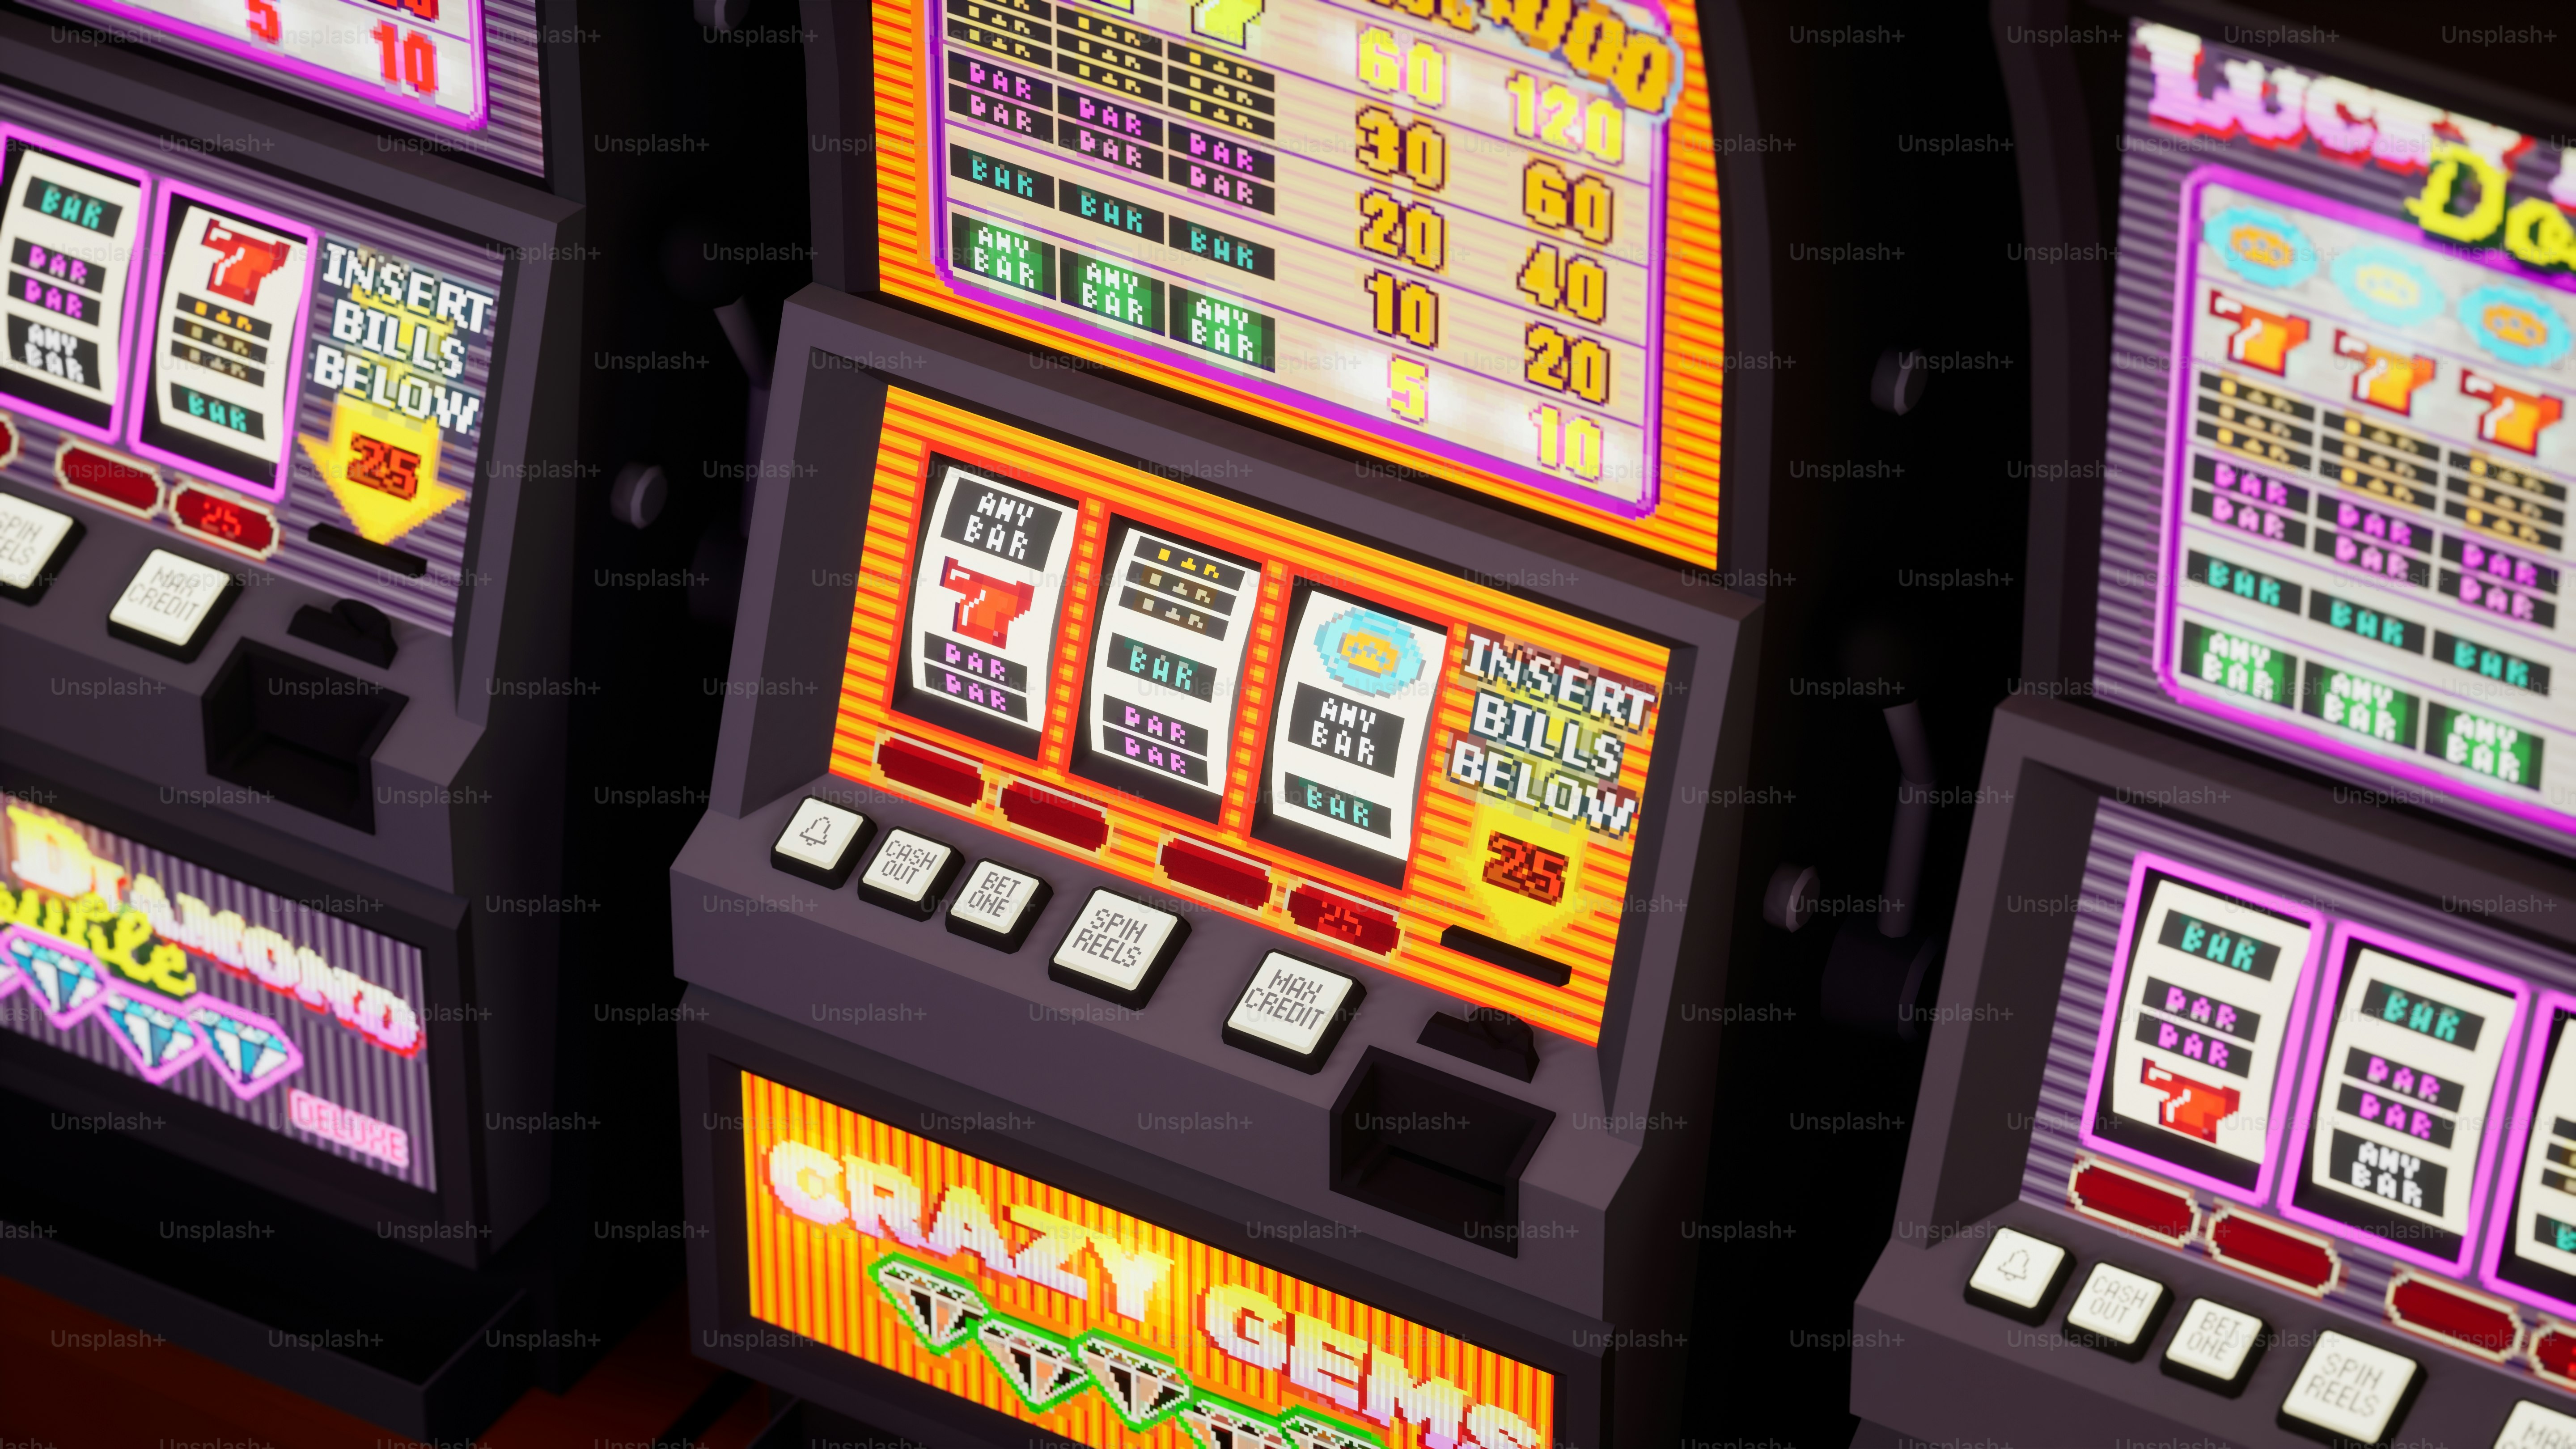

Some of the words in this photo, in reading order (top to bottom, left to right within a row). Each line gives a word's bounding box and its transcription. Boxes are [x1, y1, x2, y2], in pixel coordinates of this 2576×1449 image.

[370, 18, 439, 97] 10
[1356, 25, 1446, 111] 60
[1505, 70, 1626, 167] 120
[1356, 105, 1445, 192] 30
[1523, 158, 1613, 246] 60
[1359, 186, 1445, 273] 20
[1516, 241, 1607, 325] 40
[322, 243, 493, 333] INSERT
[979, 227, 1029, 258] ANY
[1087, 263, 1138, 294] ANY
[1196, 299, 1248, 331] ANY
[974, 246, 1034, 288] BAR
[1083, 282, 1143, 325] BAR
[1192, 318, 1253, 361] BAR
[28, 323, 77, 356] ANY
[333, 298, 465, 378] BILLS
[1364, 268, 1439, 351] 10
[1524, 321, 1610, 407] 20
[25, 343, 85, 384] BAR
[314, 344, 479, 434] BELOW
[1387, 353, 1429, 426] 5
[1528, 402, 1603, 484] 10
[347, 432, 421, 501] 25
[201, 501, 242, 538] 25
[977, 492, 1034, 526] ANY
[964, 515, 1028, 560] BAR
[127, 583, 199, 622] CREDIT
[1464, 634, 1655, 727] INSERT
[2209, 632, 2271, 669] ANY
[2331, 673, 2393, 709] ANY
[2454, 713, 2517, 751] ANY
[1320, 698, 1376, 733] ANY
[1473, 692, 1621, 777] BILLS
[2202, 652, 2273, 701] BAR
[2323, 692, 2396, 742] BAR
[2446, 733, 2520, 783] BAR
[1311, 720, 1375, 766] BAR
[1451, 739, 1635, 831] BELOW
[881, 860, 919, 884] OUT
[886, 840, 938, 870] CASH
[1482, 830, 1569, 906] 25
[968, 890, 1009, 917] ONE
[981, 871, 1021, 898] BET
[1090, 908, 1148, 944] SPIN
[1319, 901, 1362, 937] 25
[1072, 928, 1142, 968] REELS
[1244, 987, 1325, 1030] CREDIT
[1268, 969, 1323, 1004] MAX
[288, 1087, 409, 1168] DELUXE
[2359, 1142, 2420, 1179] ANY
[2351, 1162, 2422, 1208] BAR
[767, 1139, 1175, 1323] CRAZY
[2090, 1297, 2131, 1324] OUT
[2092, 1276, 2148, 1308] CASH
[2199, 1311, 2241, 1340] BET
[2321, 1353, 2384, 1391] SPIN
[2305, 1374, 2380, 1417] REELS
